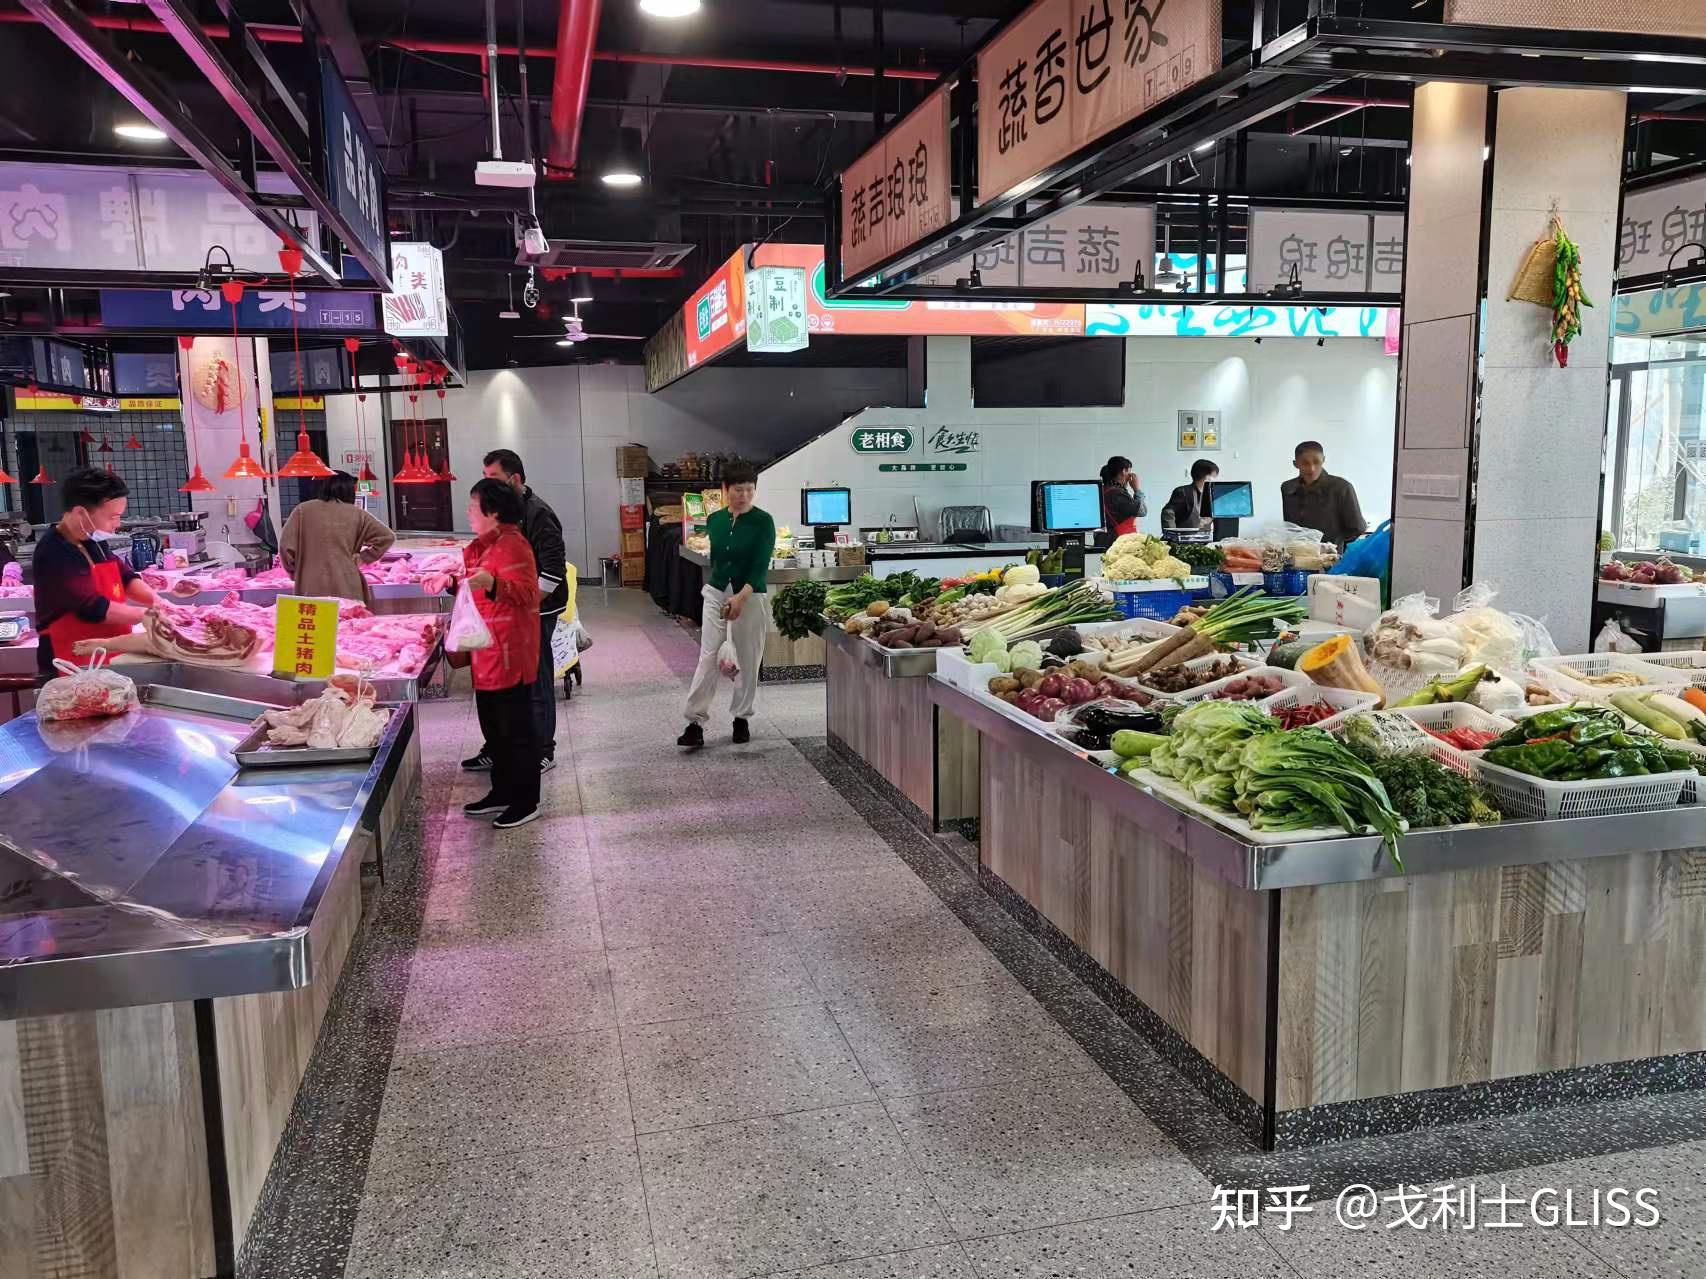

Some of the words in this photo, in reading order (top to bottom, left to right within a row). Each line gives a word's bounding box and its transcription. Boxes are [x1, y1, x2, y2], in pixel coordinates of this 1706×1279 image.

[321, 311, 363, 323] T-15
[858, 432, 906, 449] 老相食
[296, 602, 317, 674] 精品土猪肉
